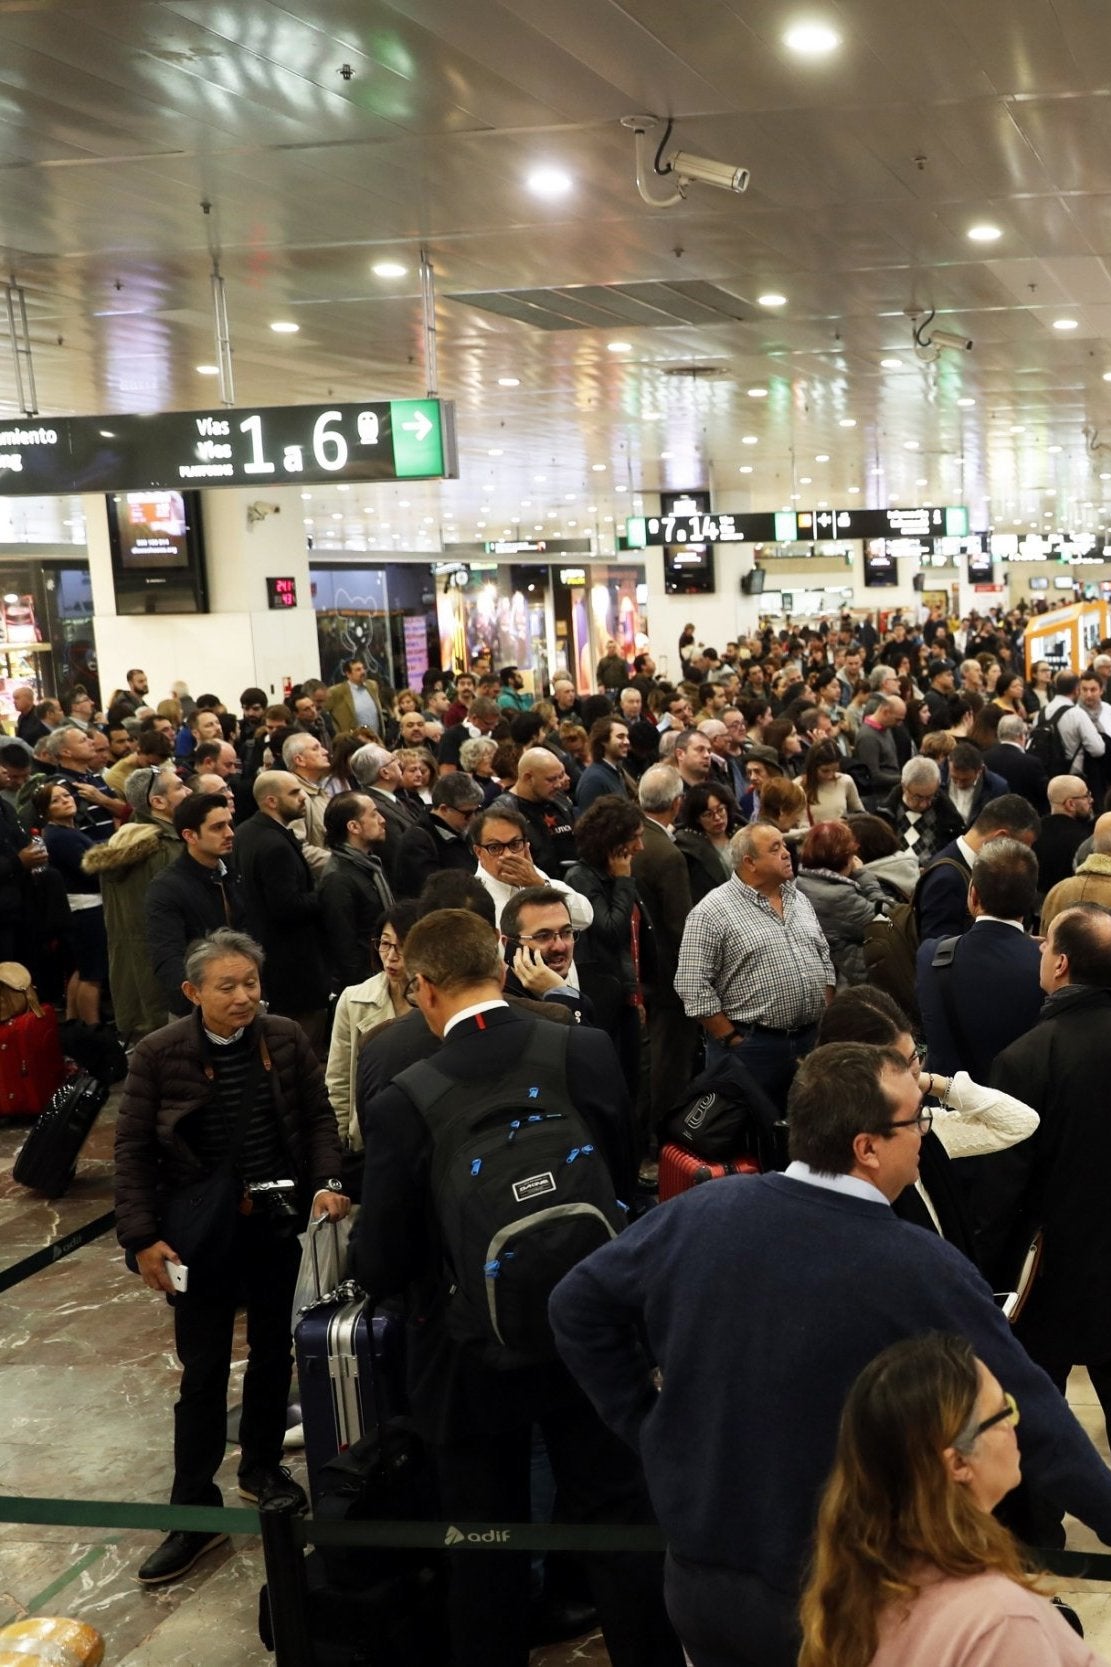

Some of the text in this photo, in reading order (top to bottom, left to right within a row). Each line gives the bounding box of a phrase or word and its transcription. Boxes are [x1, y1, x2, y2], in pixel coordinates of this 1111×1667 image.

[196, 417, 230, 436] Vías
[0, 428, 57, 446] miento
[239, 410, 348, 474] 1 a 6
[467, 1528, 511, 1543] adif
